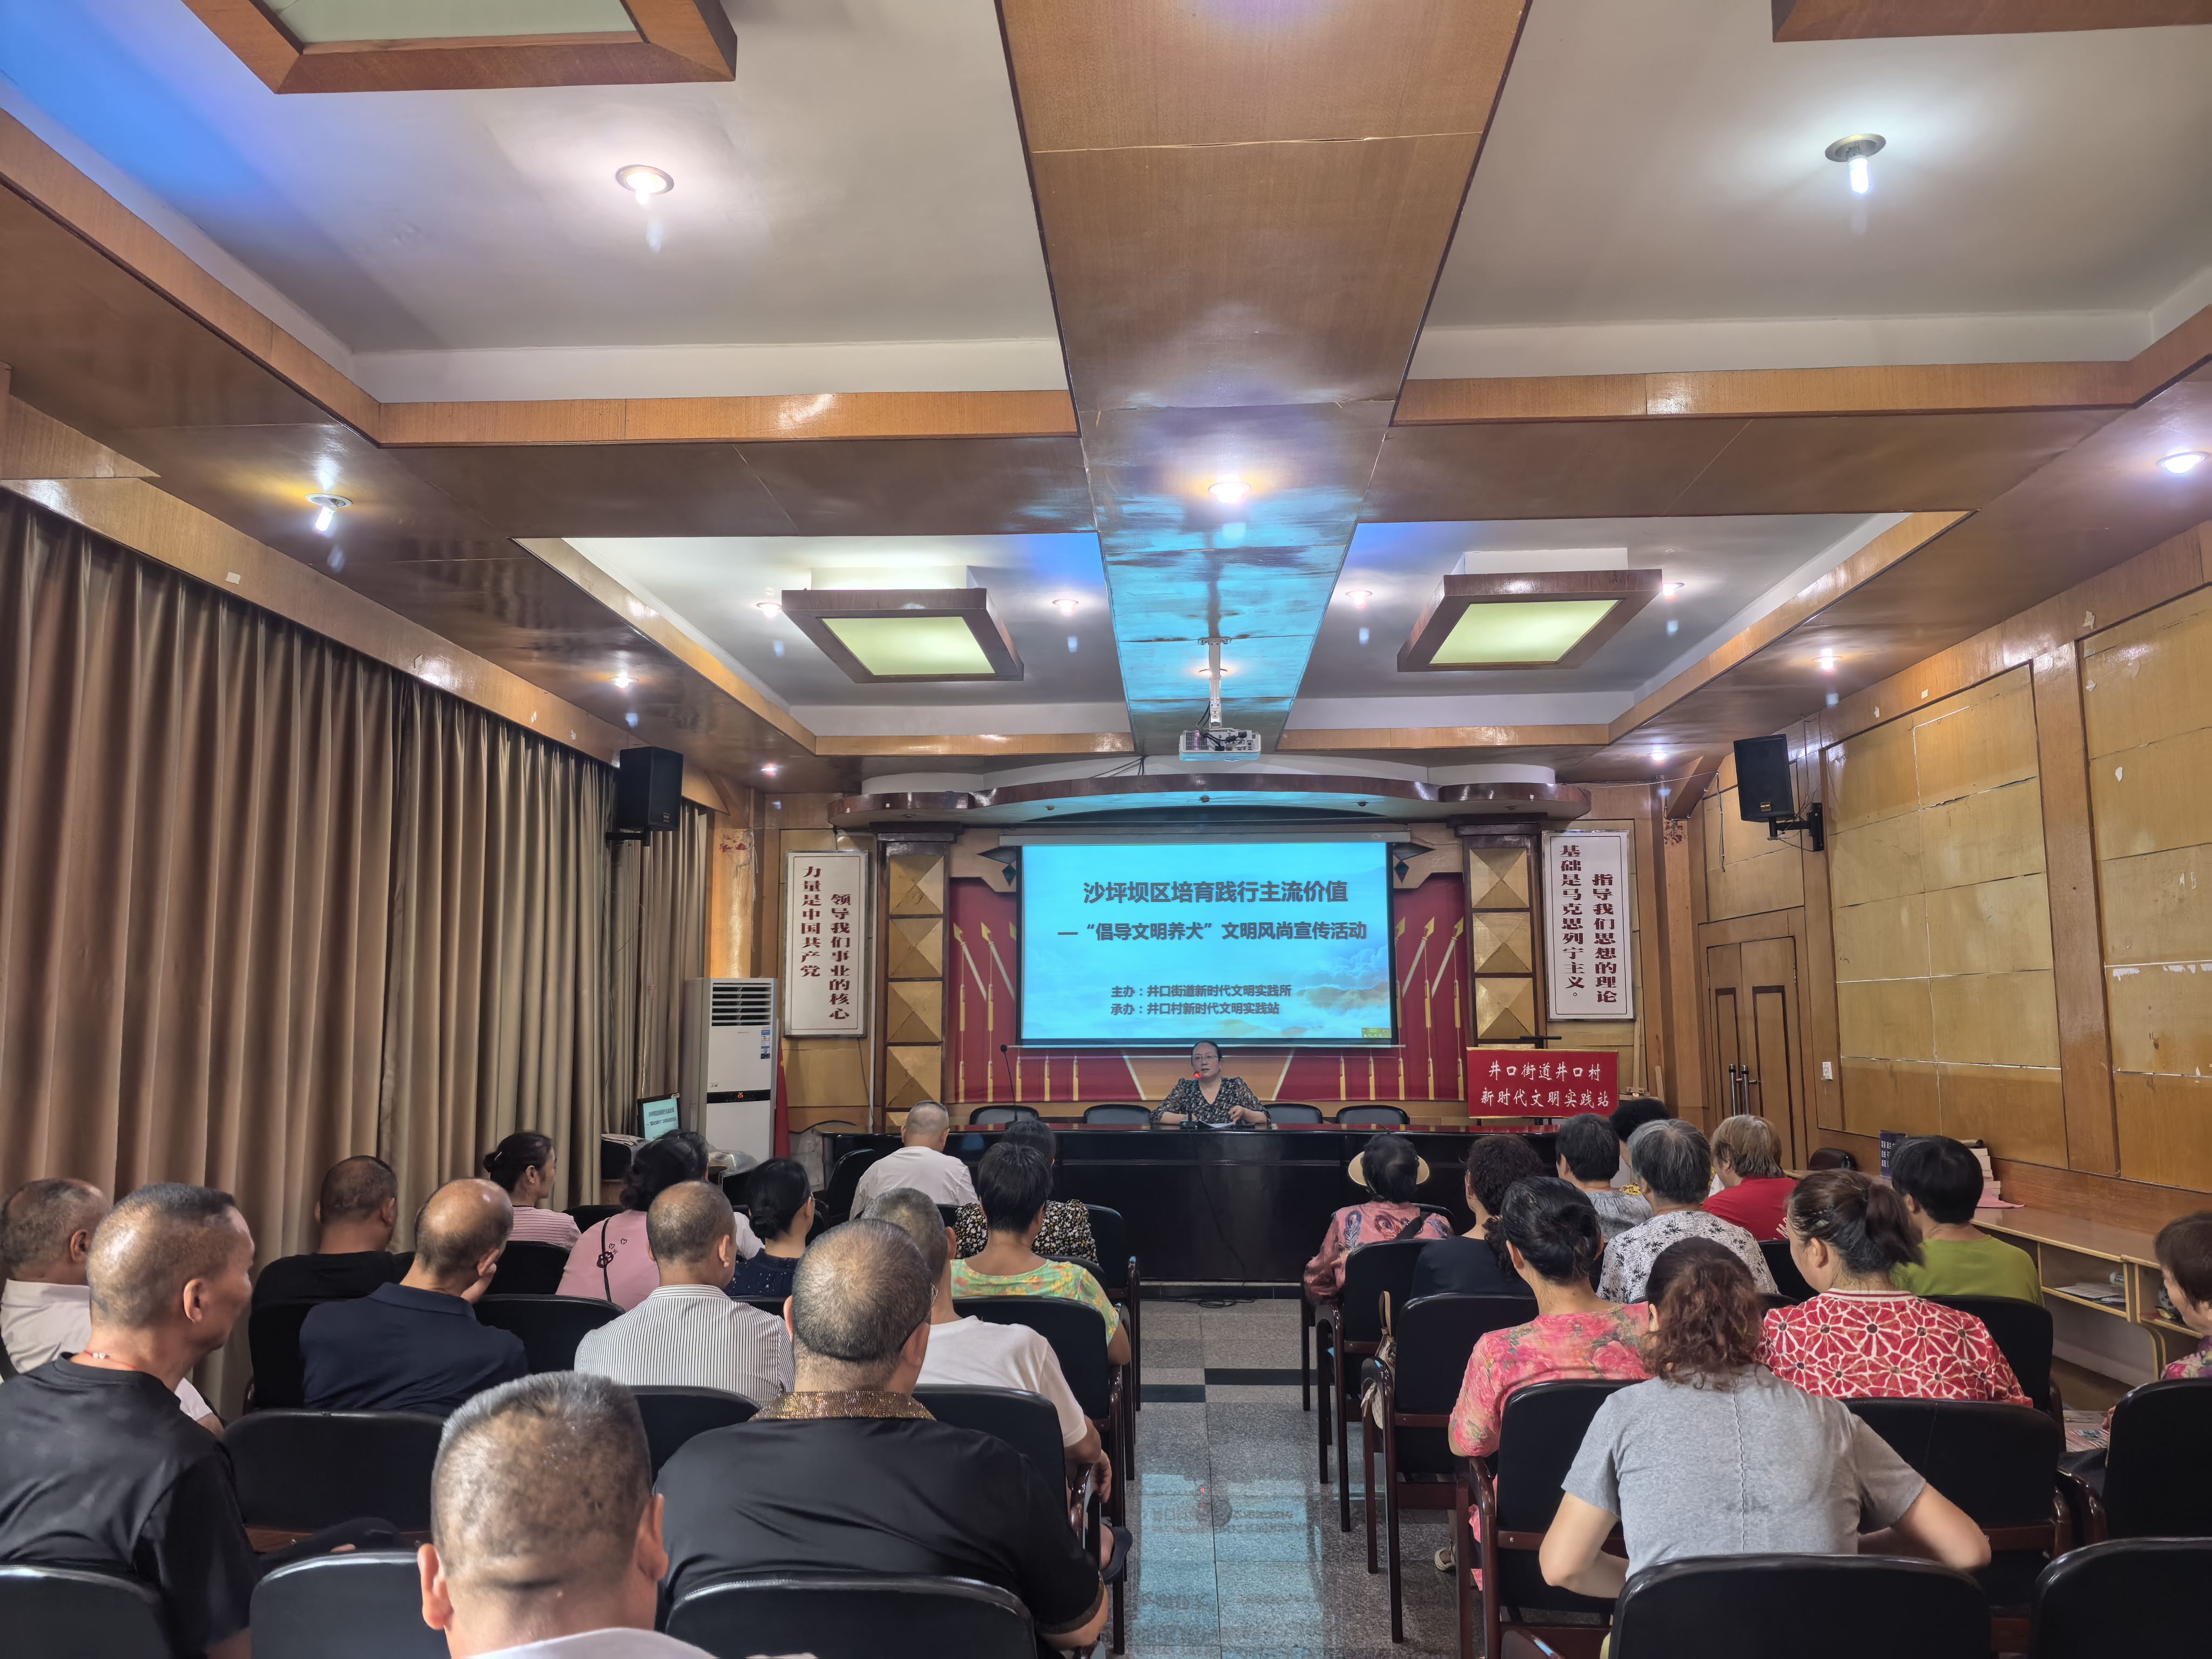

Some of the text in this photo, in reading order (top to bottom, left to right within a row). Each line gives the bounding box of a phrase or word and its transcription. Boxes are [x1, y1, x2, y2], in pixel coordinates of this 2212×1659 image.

[800, 866, 822, 977] 力量是中国共产党
[1083, 881, 1348, 904] 沙坪坝区培育践行主流价值
[829, 894, 851, 1020] 领导我们事业的核心
[1591, 873, 1617, 1003] 指导我们思想的理论
[1481, 1087, 1609, 1109] 新时代文明实践站
[1489, 1060, 1601, 1082] 井口街道井口村
